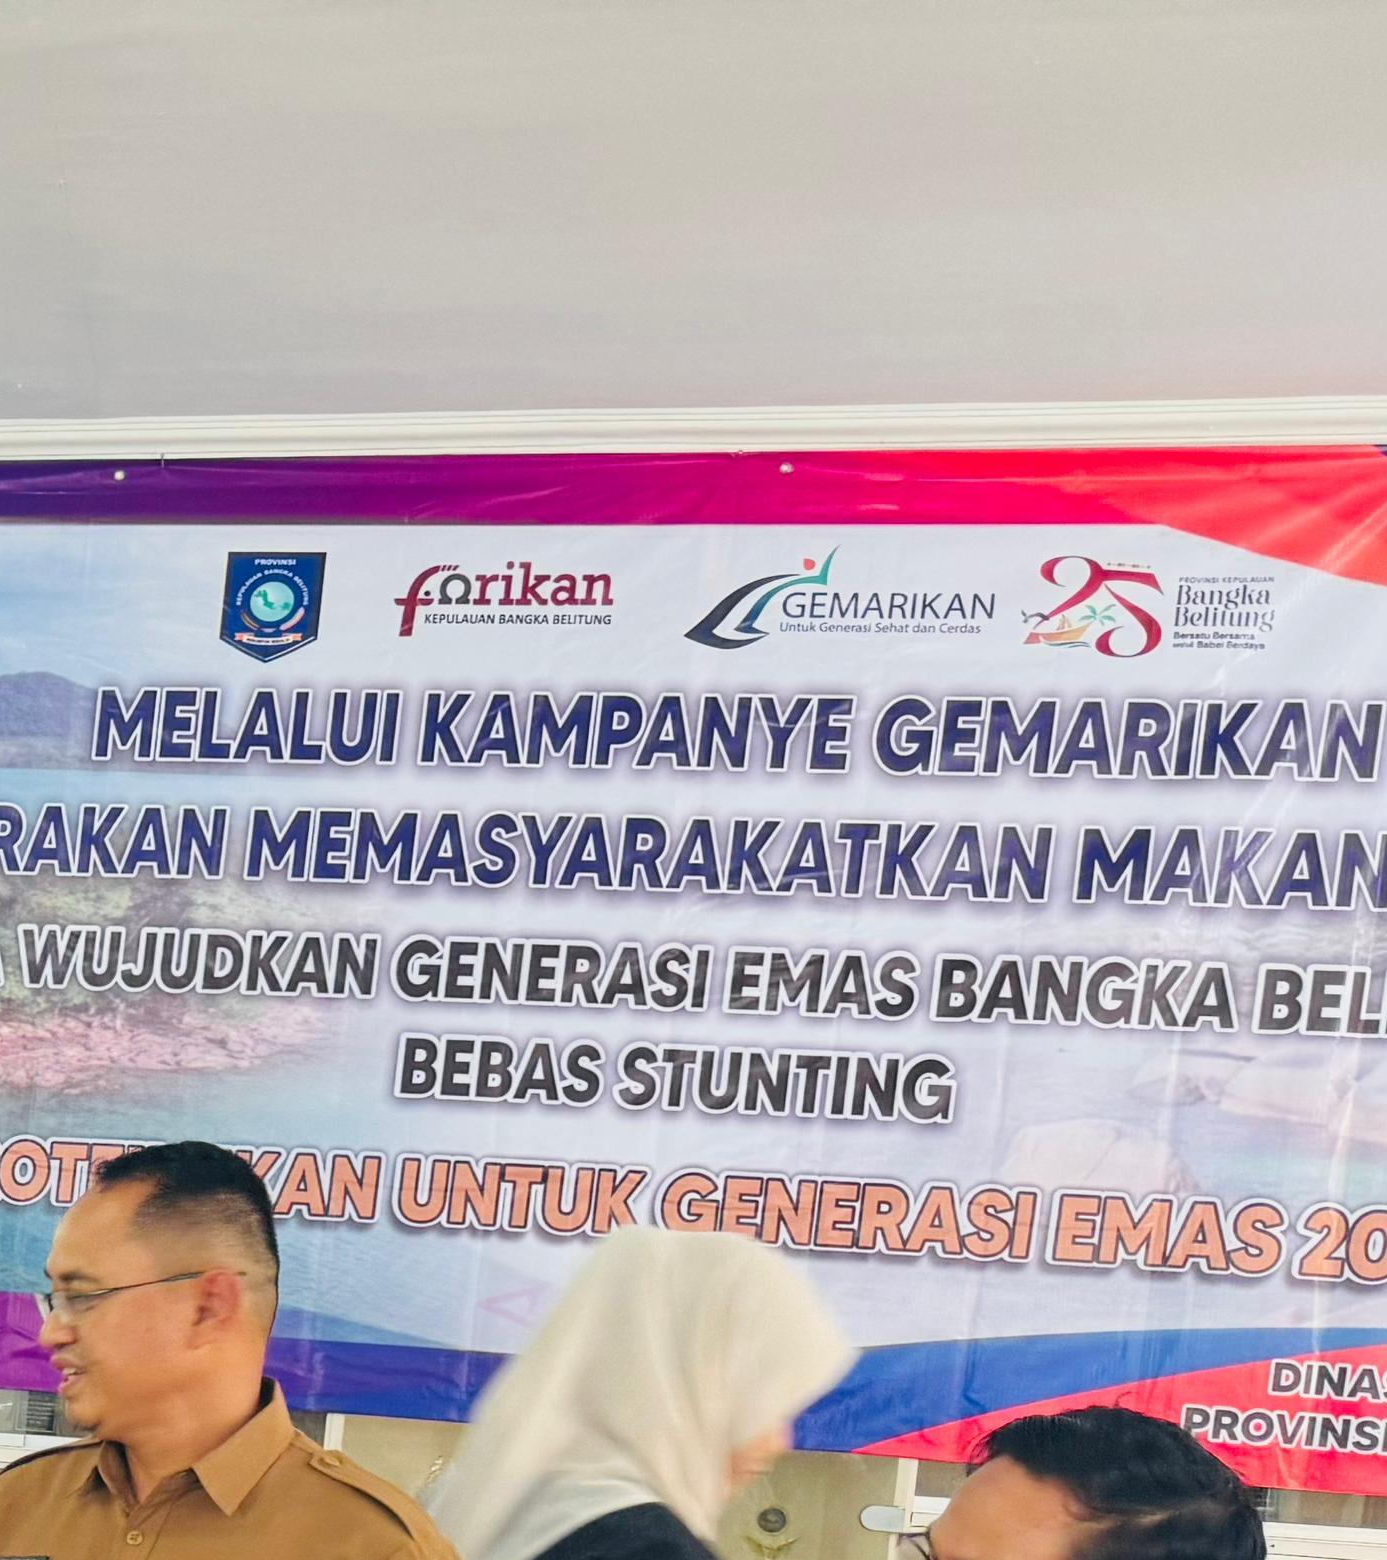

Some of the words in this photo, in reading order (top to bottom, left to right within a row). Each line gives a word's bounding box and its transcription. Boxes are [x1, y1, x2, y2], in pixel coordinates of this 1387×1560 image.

[782, 592, 995, 620] GEMARIKAN
[1177, 584, 1270, 610] Bangka
[424, 613, 495, 625] KEPULAUAN
[498, 613, 549, 625] BANGKA
[552, 614, 612, 626] BELITUNG
[779, 621, 817, 633] Untuk
[819, 621, 872, 633] Generasi
[875, 622, 910, 634] Sehat
[912, 622, 936, 634] dan
[938, 623, 982, 634] Cerdas
[1174, 606, 1275, 633] Belitung
[94, 688, 400, 764] MELALUI
[420, 692, 853, 773] KAMPANYE
[877, 697, 1385, 780] GEMARIKAN
[245, 808, 1053, 901] MEMASYARAKATKAN
[1074, 827, 1387, 910] MAKAN
[19, 924, 380, 998] WUJUDKAN
[393, 938, 709, 1011] GENERASI
[726, 949, 918, 1020] EMAS
[935, 957, 1237, 1033] BANGKA
[395, 1034, 601, 1107] BEBAS
[618, 1042, 956, 1123] STUNTING
[398, 1156, 648, 1234] UNTUK
[660, 1171, 1039, 1259] GENERASI
[1050, 1193, 1285, 1275] EMAS
[1270, 1361, 1387, 1400] DINA
